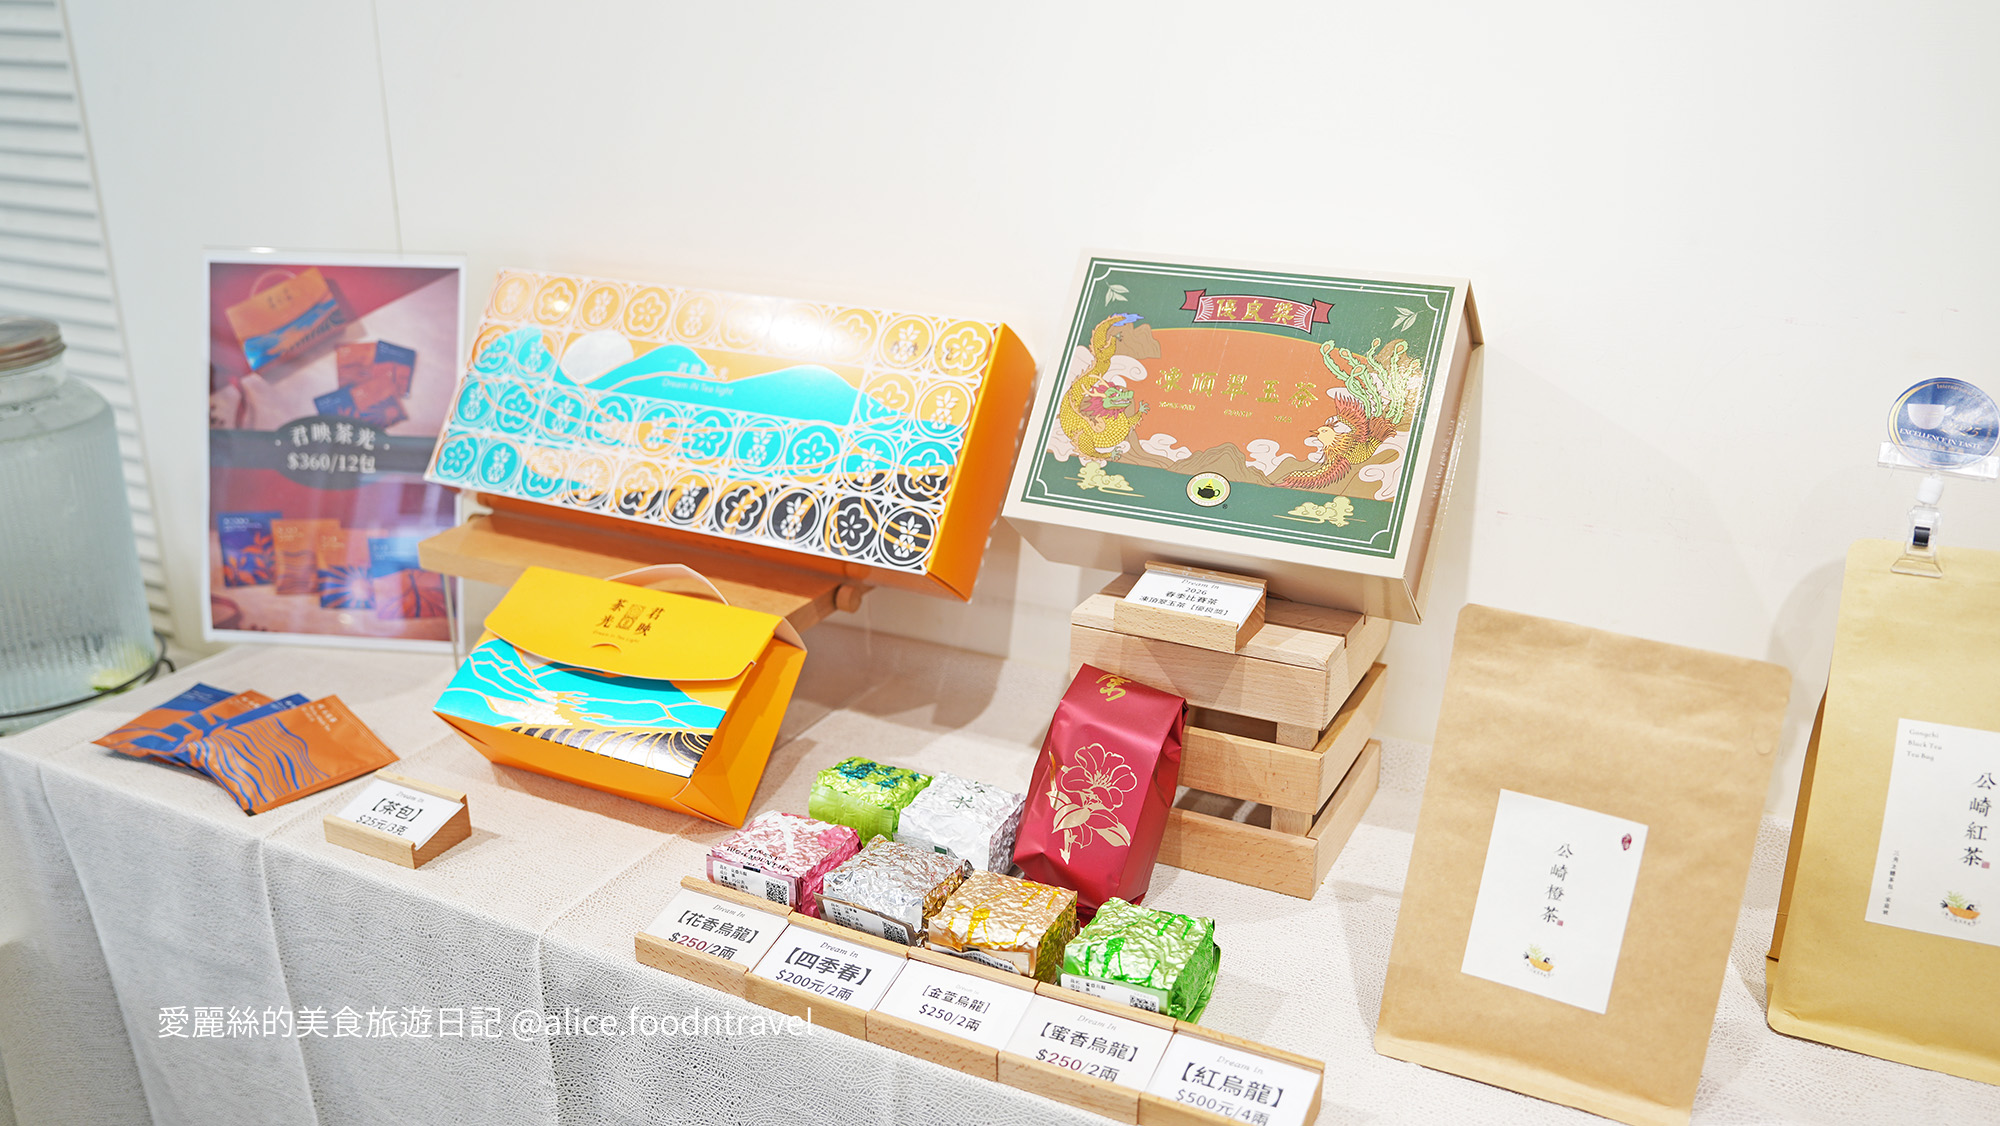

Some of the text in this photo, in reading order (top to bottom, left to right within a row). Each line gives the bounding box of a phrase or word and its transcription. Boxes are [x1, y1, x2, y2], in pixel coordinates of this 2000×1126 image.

[290, 422, 376, 451] 君映茶光
[1899, 427, 1946, 443] EXCELLENCE
[1948, 438, 1958, 446] IN
[287, 452, 376, 474] $360/12包
[1181, 579, 1208, 588] Dream
[356, 814, 408, 836] $25元/3克
[1959, 772, 1997, 867] 公崎紅茶
[1540, 843, 1573, 923] 公崎橙茶
[713, 904, 737, 916] Dream
[668, 931, 738, 961] $250/2兩
[819, 941, 847, 955] Dream
[784, 947, 873, 987] 【四季春】
[775, 969, 854, 1002] $200元/2兩
[918, 1003, 982, 1032] $250/2兩
[1077, 1014, 1105, 1028] Dream
[1035, 1048, 1120, 1082] $250/2兩
[1217, 1055, 1250, 1071] Dream
[1175, 1089, 1270, 1126] $500元/4兩
